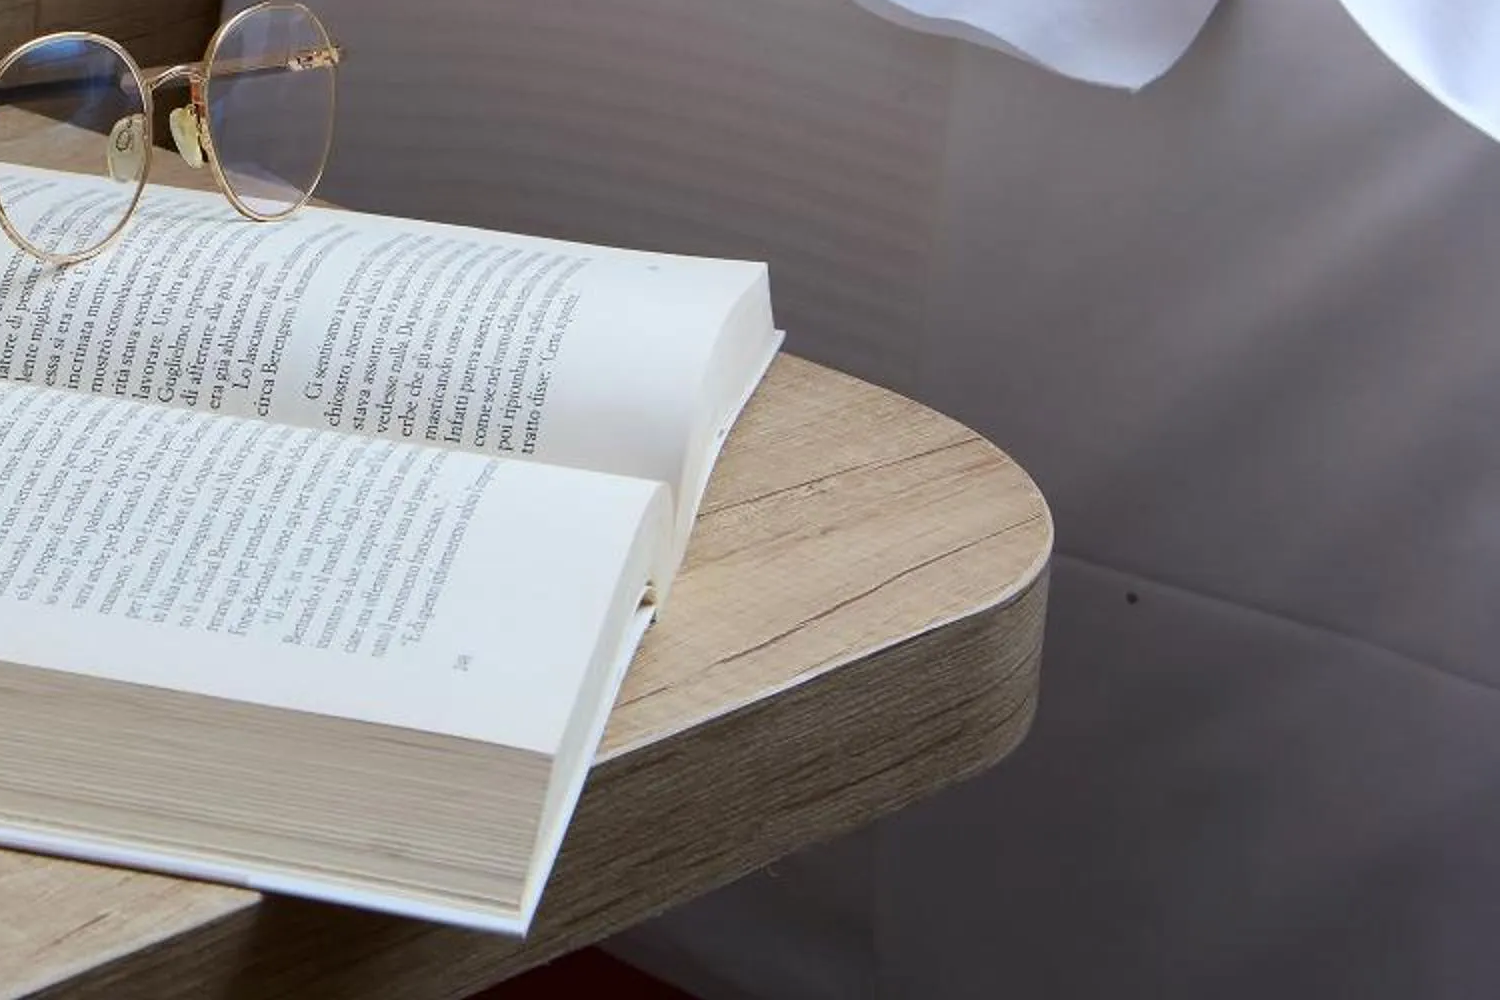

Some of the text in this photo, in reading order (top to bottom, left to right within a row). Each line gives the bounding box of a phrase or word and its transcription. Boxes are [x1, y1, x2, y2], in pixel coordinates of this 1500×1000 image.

[4, 314, 24, 330] di
[56, 312, 74, 334] era
[62, 276, 112, 390] incrinata mentre
[237, 302, 274, 364] lasciammo
[48, 337, 65, 349] si
[118, 330, 140, 366] stava
[184, 324, 216, 385] afferrare
[208, 292, 252, 409] era già abbastanza
[310, 316, 342, 378] sentivamo
[412, 352, 432, 369] gli
[15, 344, 39, 383] lente
[44, 354, 60, 387] essa
[90, 338, 112, 392] mostrò
[112, 368, 130, 395] rità
[132, 332, 164, 399] lavorare.
[232, 368, 252, 390] Lo
[324, 360, 355, 427] chiostro,
[340, 322, 366, 357] incerti
[352, 388, 371, 430] stava
[364, 336, 386, 384] assorto
[484, 366, 501, 386] nel
[500, 342, 534, 420] ripiombava
[180, 388, 198, 406] di
[254, 378, 275, 417] circa
[304, 382, 323, 400] Ci
[404, 372, 424, 396] che
[422, 358, 454, 440] masticando
[444, 396, 468, 444] Infatti
[458, 350, 482, 393] pareva
[484, 388, 496, 404] se
[376, 376, 398, 434] vedesse
[398, 400, 418, 437] erbe
[473, 404, 492, 448] come
[496, 424, 514, 452] poi
[521, 410, 540, 454] tratto
